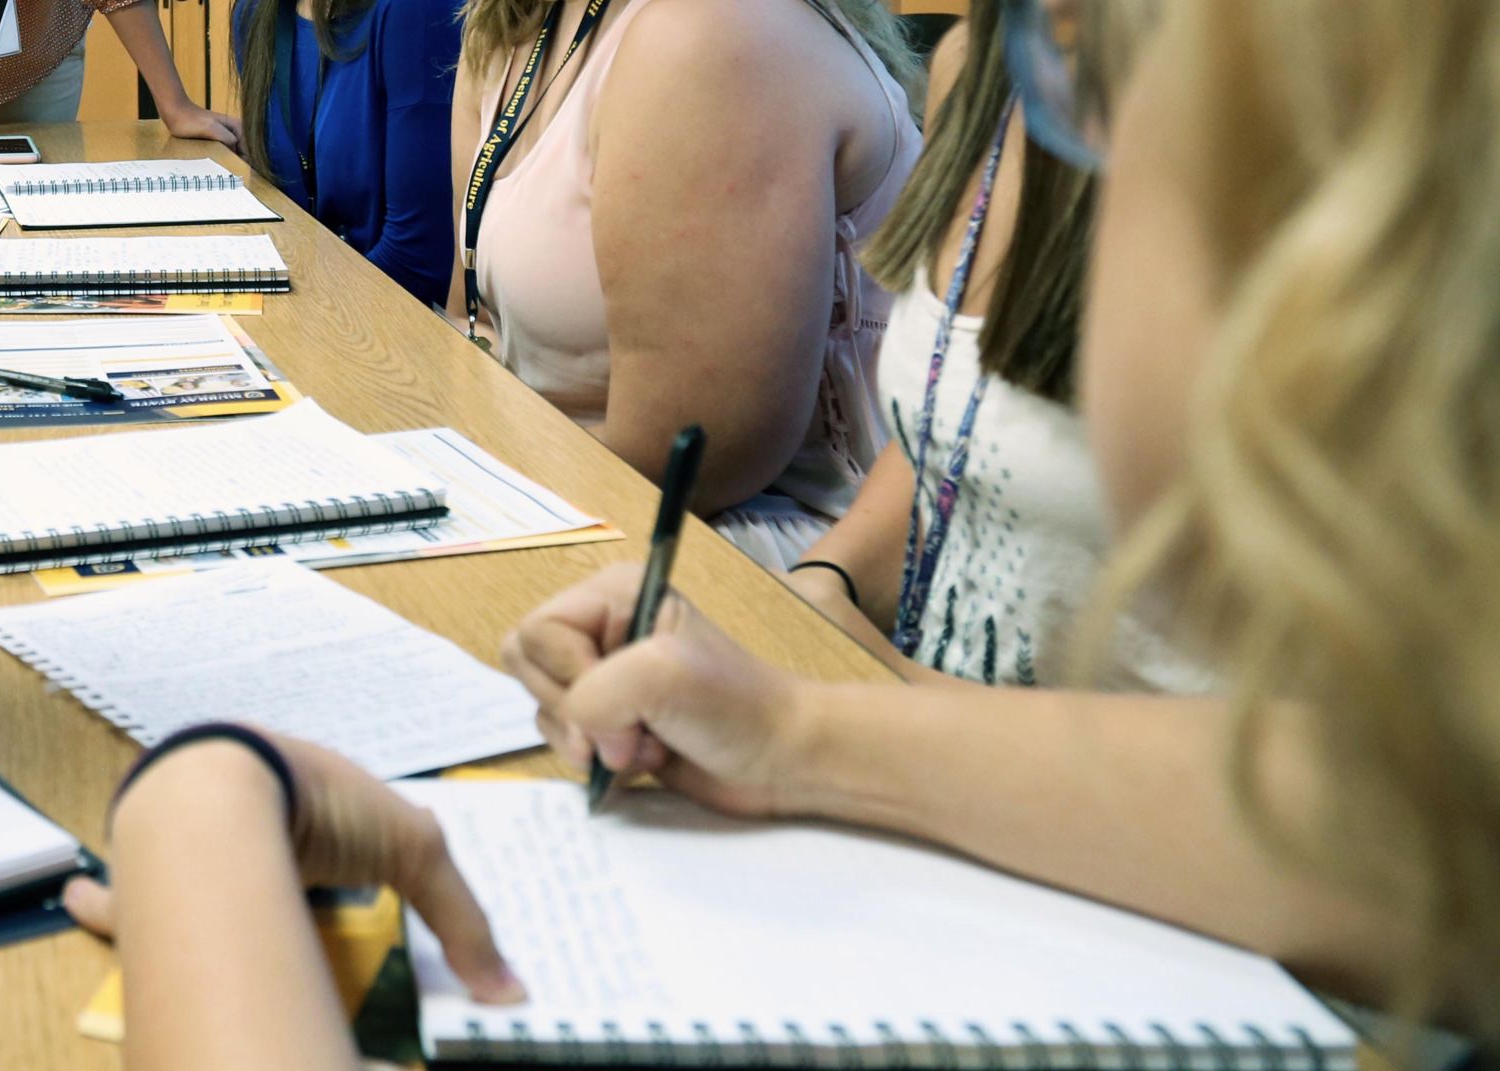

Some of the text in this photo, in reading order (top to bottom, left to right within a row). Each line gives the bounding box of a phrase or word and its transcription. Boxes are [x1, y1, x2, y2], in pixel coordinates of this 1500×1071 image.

[506, 75, 531, 118] School
[496, 118, 510, 135] of
[466, 132, 503, 211] Agriculture
